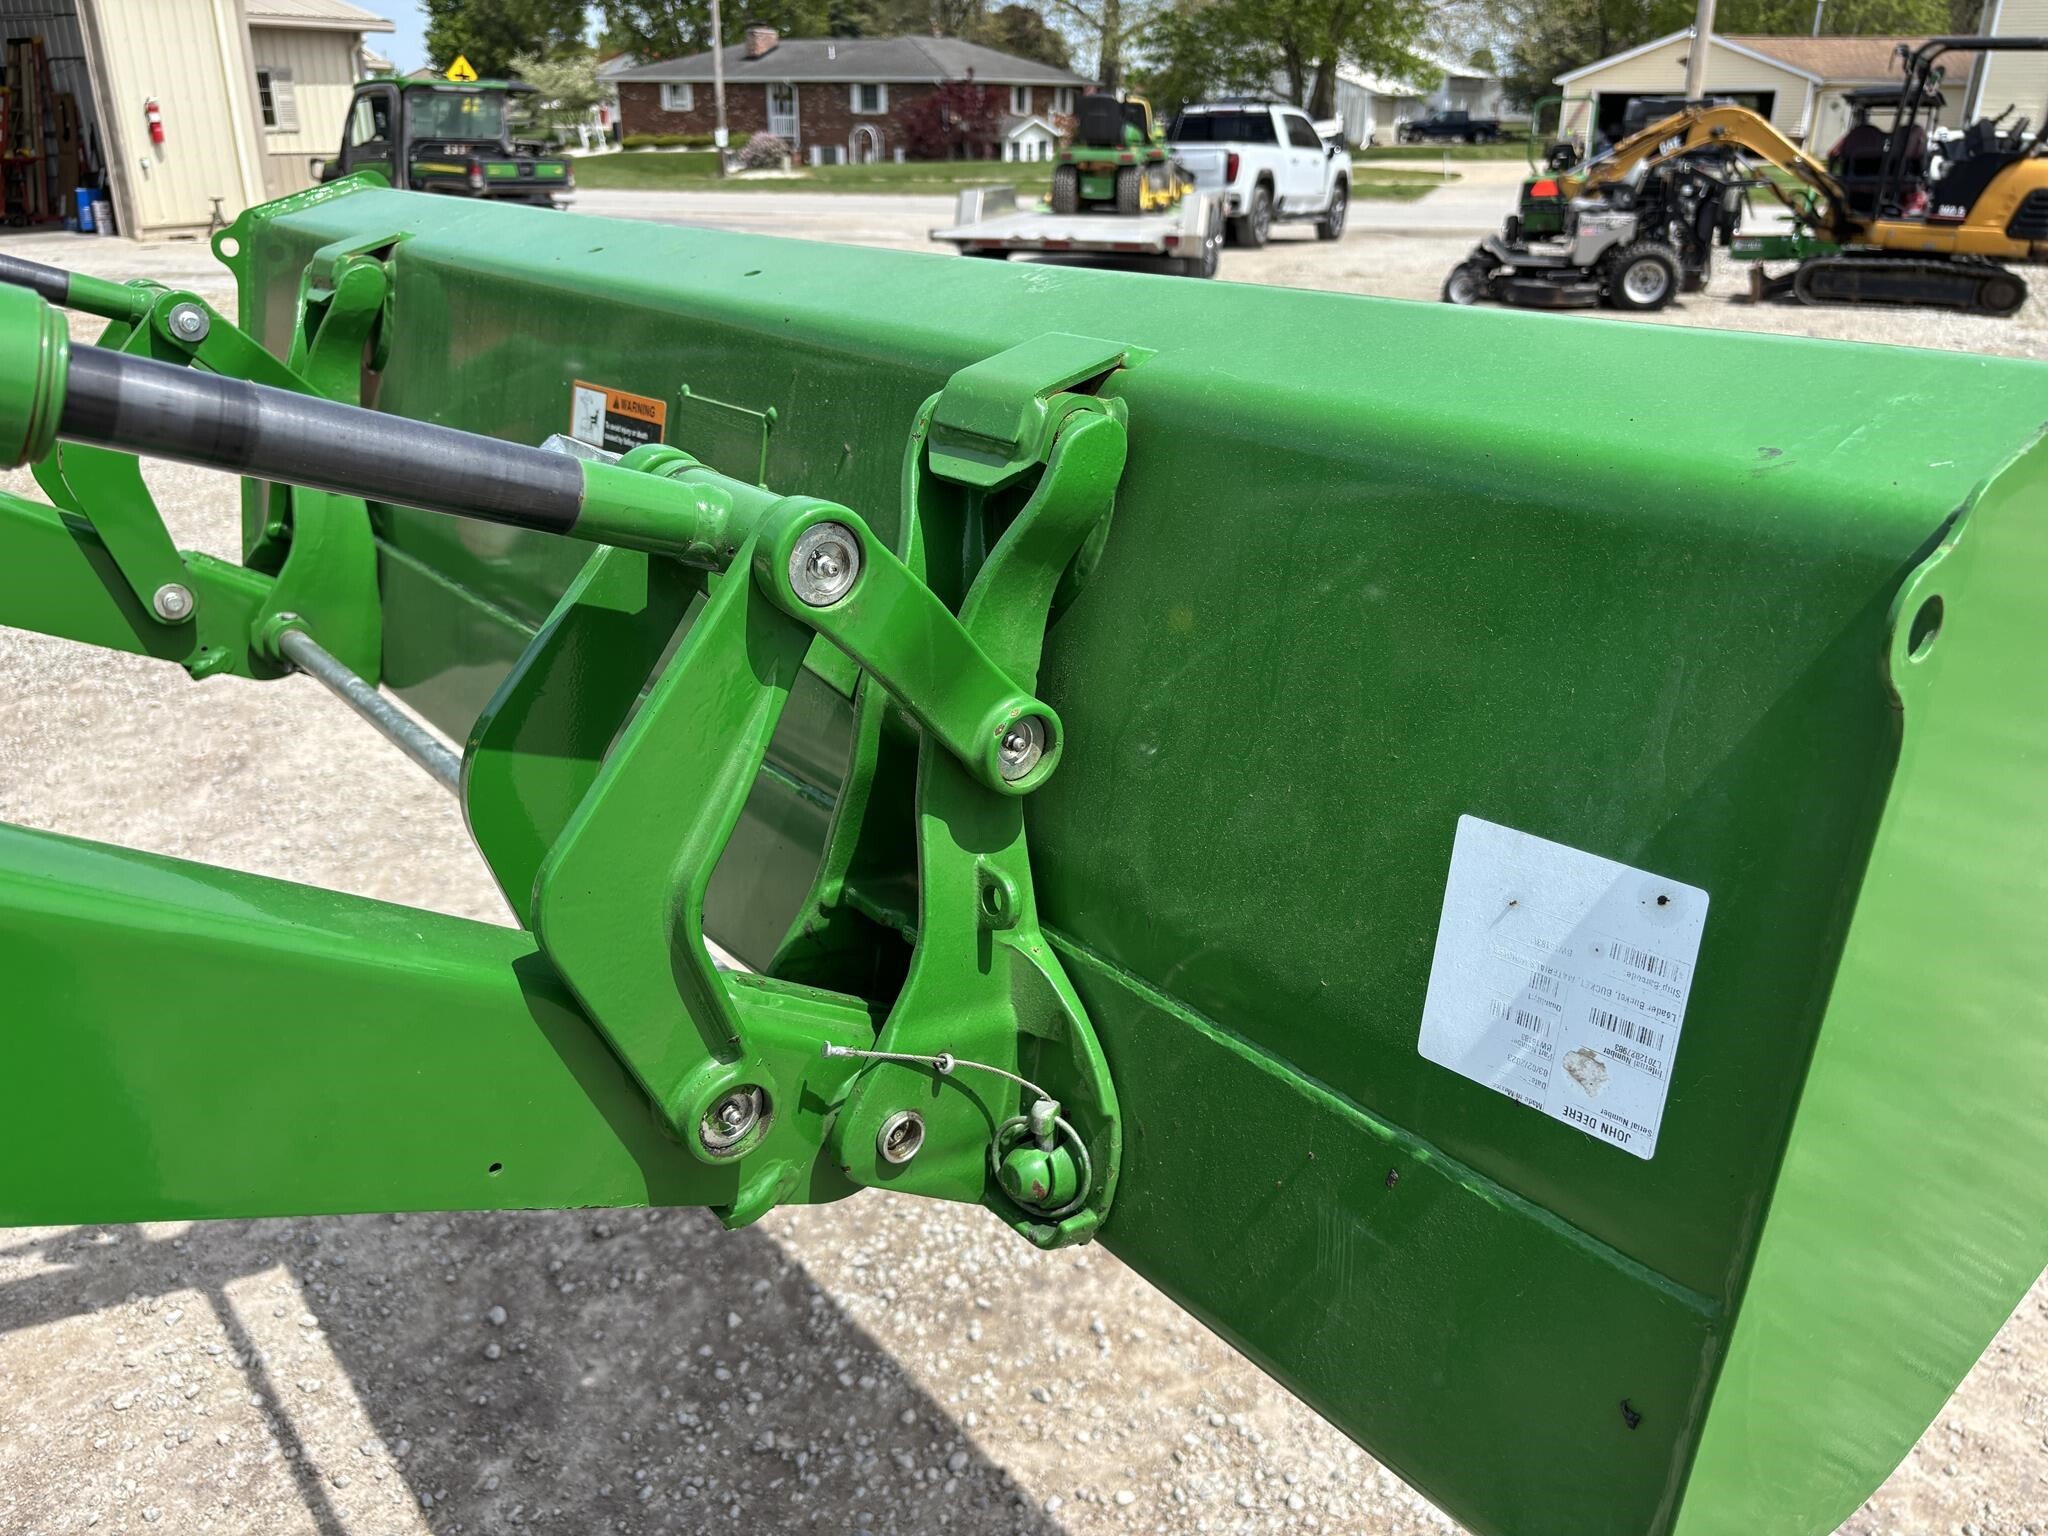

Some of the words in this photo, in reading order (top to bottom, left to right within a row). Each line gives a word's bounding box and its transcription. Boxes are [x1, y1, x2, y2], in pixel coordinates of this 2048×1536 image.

[621, 399, 656, 418] WARNING
[1660, 982, 1681, 998] Ship
[1646, 1003, 1676, 1022] Loader
[1537, 1048, 1552, 1060] Part
[1602, 1046, 1631, 1065] Number
[1633, 1059, 1662, 1077] Internal
[1523, 1095, 1542, 1110] Made
[1561, 1104, 1597, 1129] DEERE
[1599, 1107, 1629, 1127] Number
[1599, 1121, 1631, 1145] JOHN
[1630, 1121, 1652, 1137] Serial
